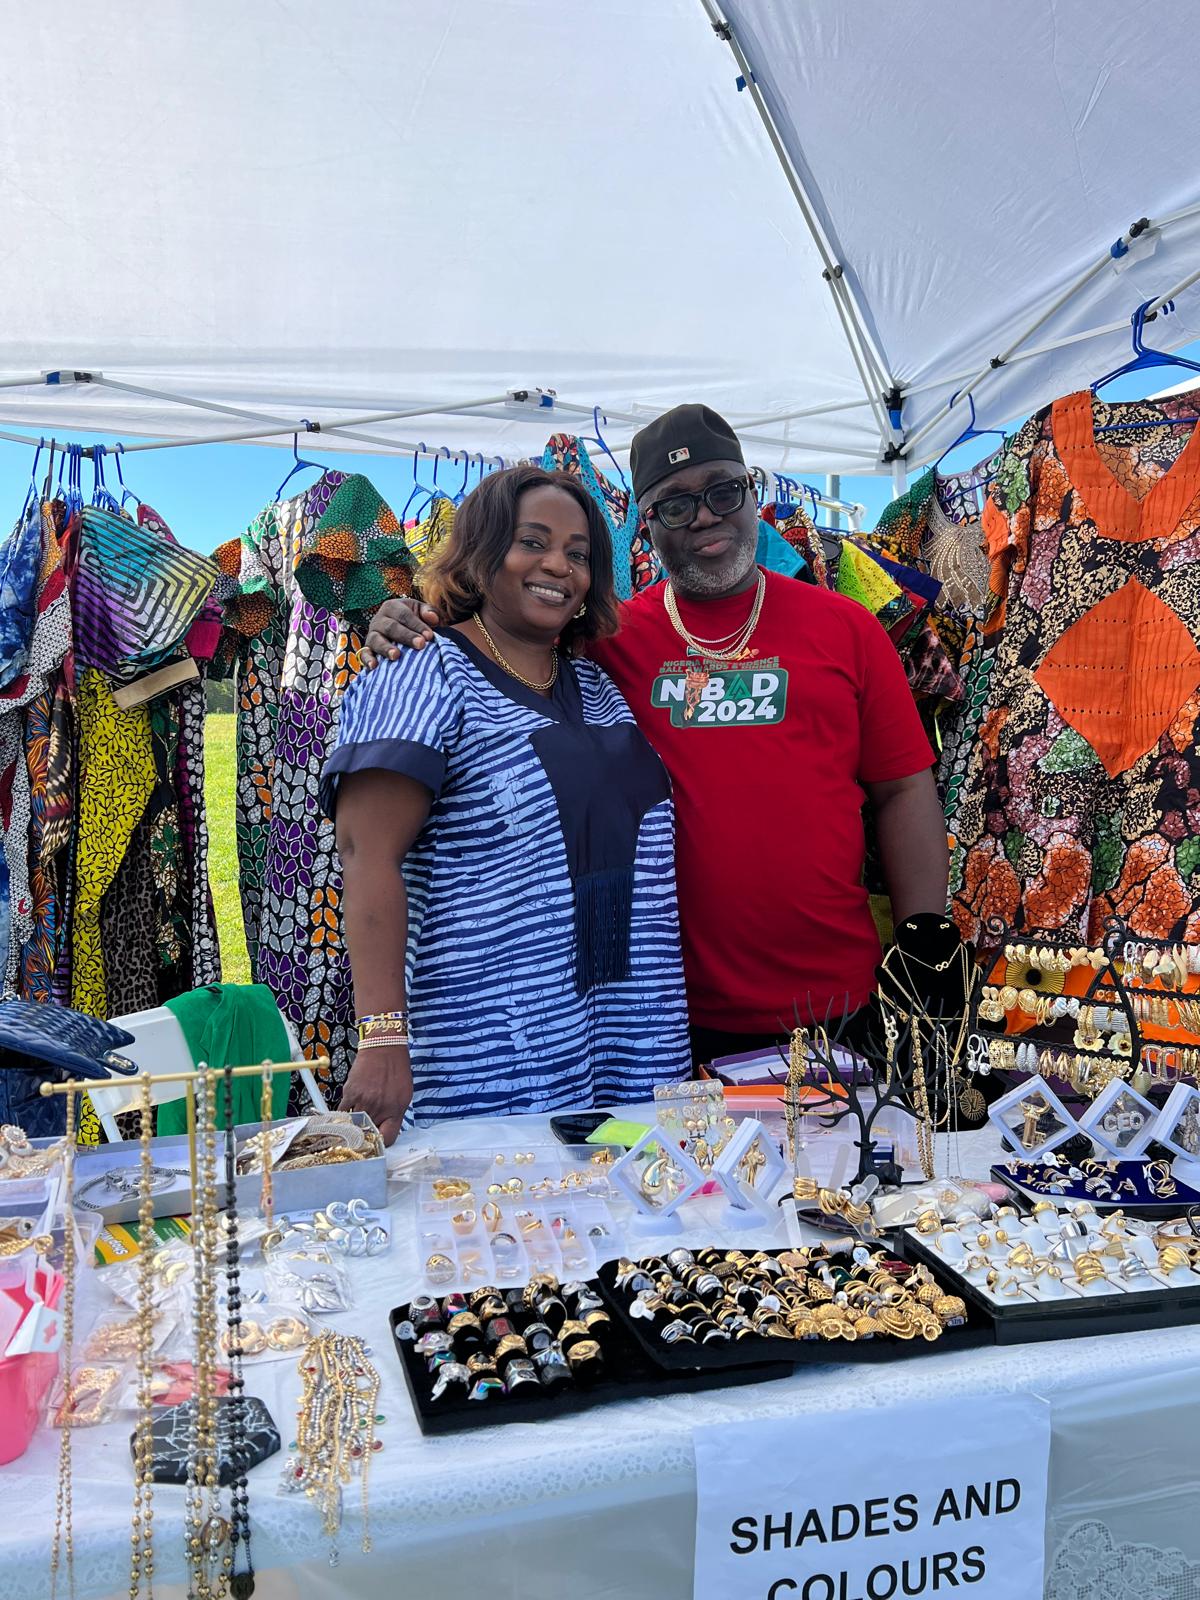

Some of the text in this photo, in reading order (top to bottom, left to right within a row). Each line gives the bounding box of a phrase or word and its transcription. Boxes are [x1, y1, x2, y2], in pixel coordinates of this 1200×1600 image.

[659, 665, 683, 673] BALL
[663, 659, 701, 667] NIGERIA
[698, 697, 777, 722] 2024
[1103, 1110, 1145, 1131] CEO
[730, 1478, 1021, 1554] SHADES AND
[767, 1545, 986, 1600] COLOURS
